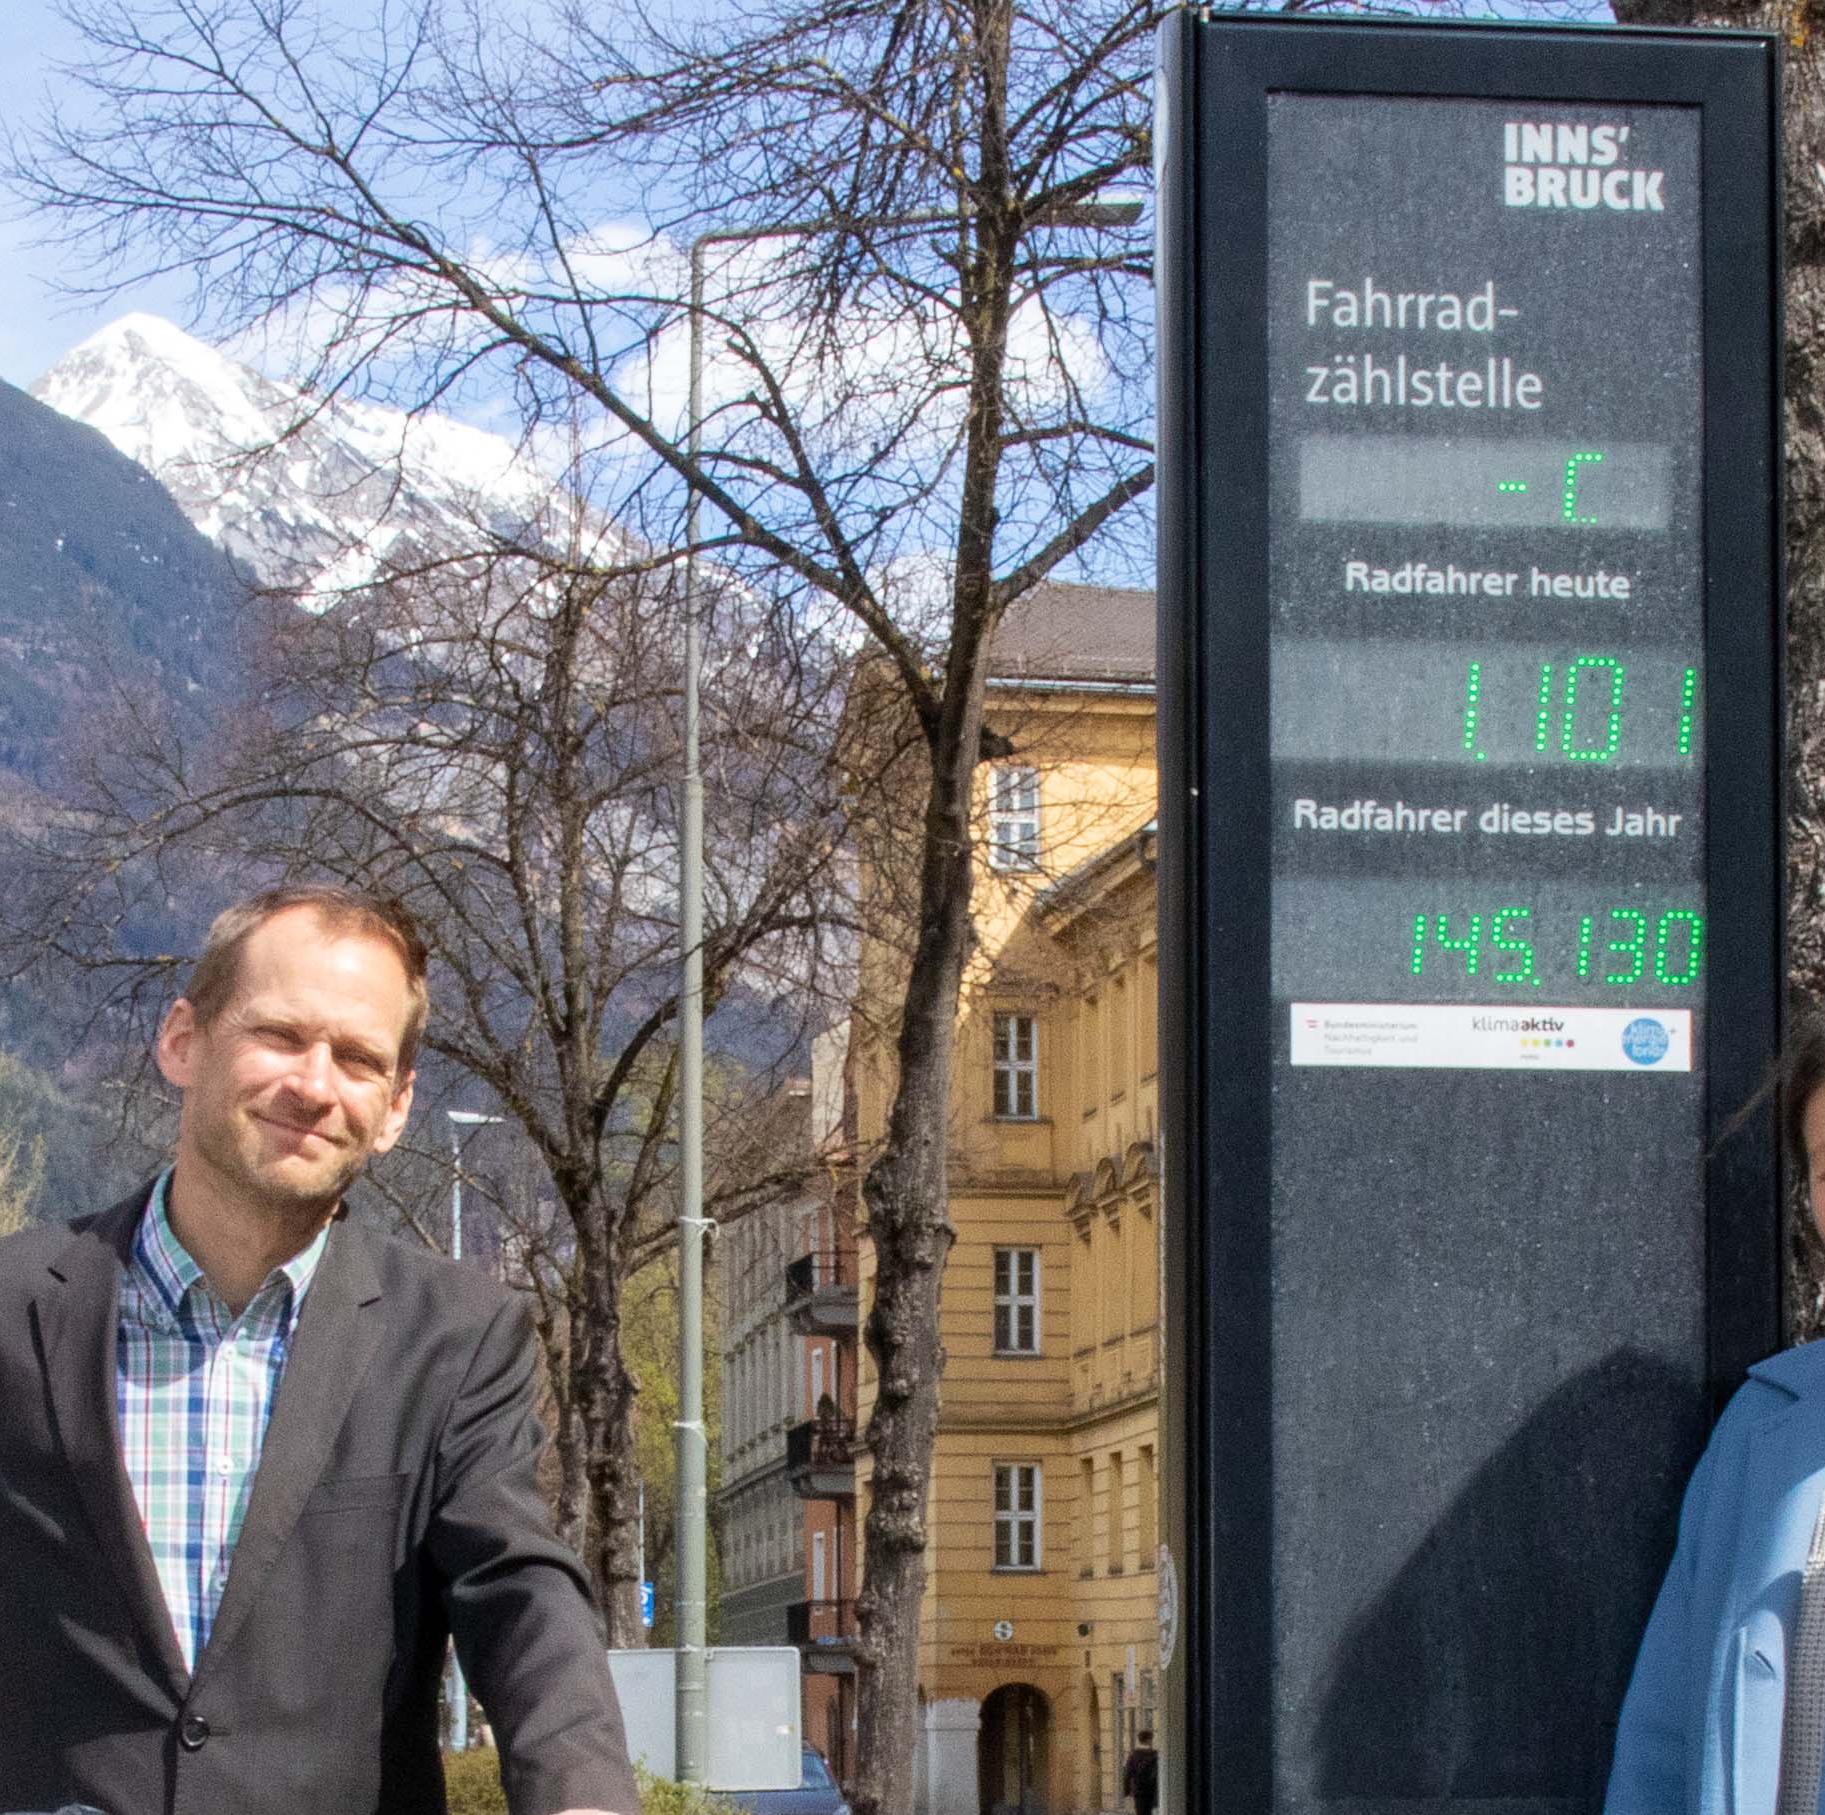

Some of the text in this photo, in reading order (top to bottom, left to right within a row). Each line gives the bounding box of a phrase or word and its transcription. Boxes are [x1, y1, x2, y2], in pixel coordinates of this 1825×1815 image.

[1504, 122, 1630, 165] INNS'
[1504, 166, 1665, 211] BRUCK
[1306, 277, 1519, 332] Fahrrad-
[1306, 354, 1543, 410] zählstelle
[1345, 561, 1631, 600] Radfahrer heute
[1293, 798, 1683, 838] Radfahrer dieses Jahr
[1410, 907, 1704, 987] 145.130
[1472, 1016, 1565, 1033] klimaaktiv
